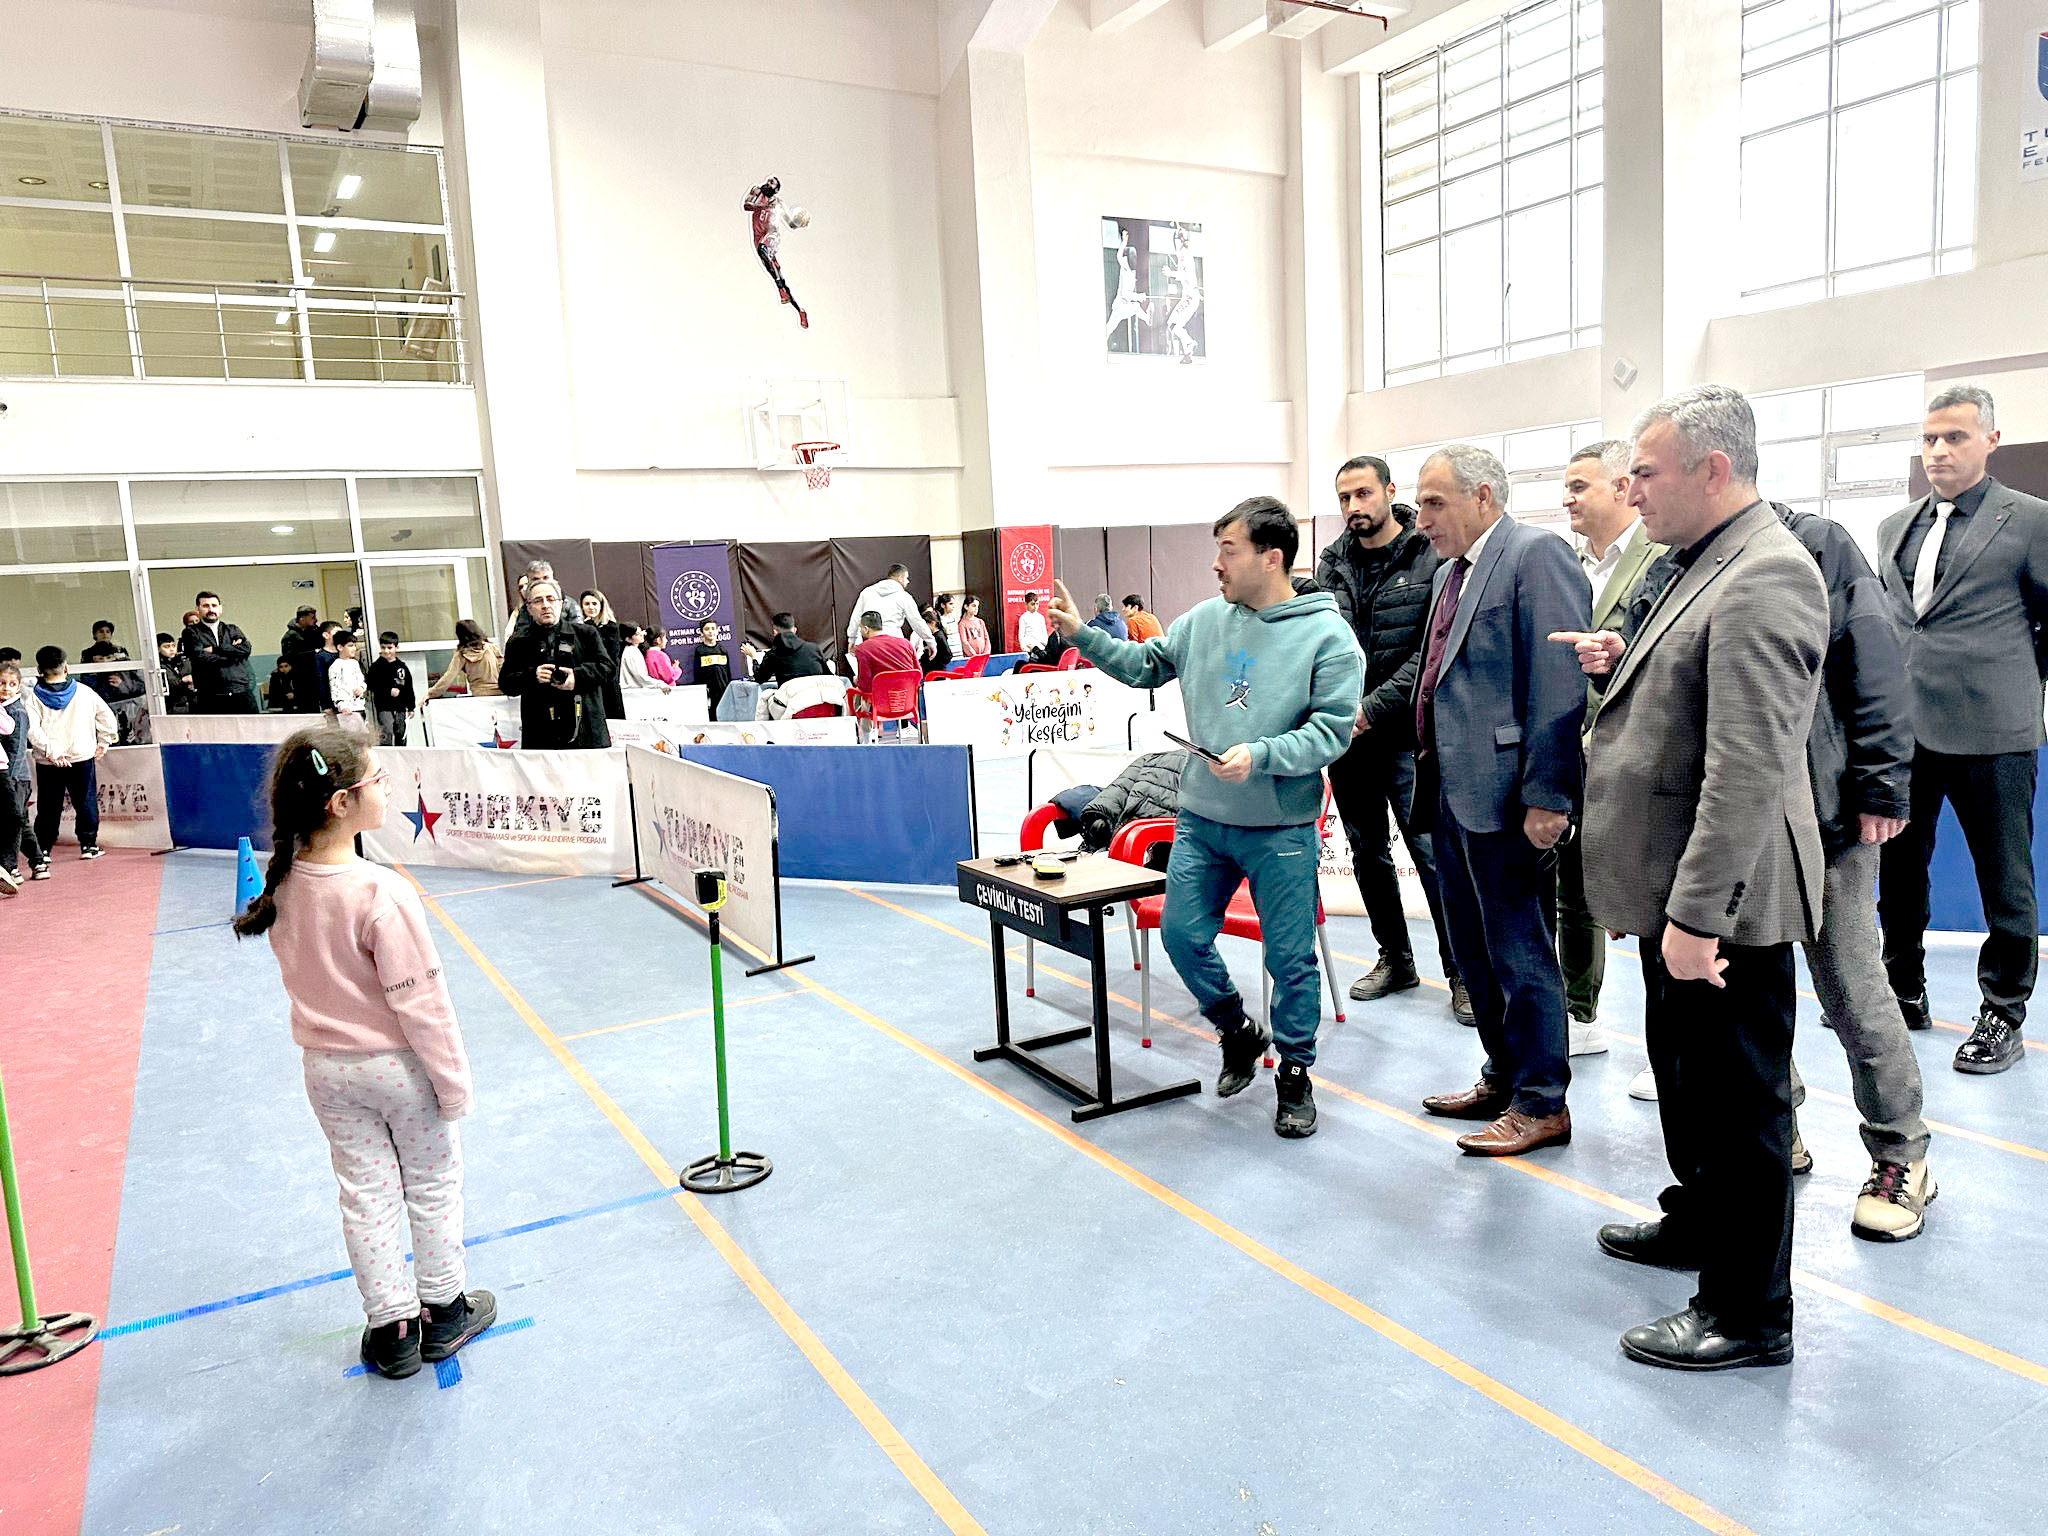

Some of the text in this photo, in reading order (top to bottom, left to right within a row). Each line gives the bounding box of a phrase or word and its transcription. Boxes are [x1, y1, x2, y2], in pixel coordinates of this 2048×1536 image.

[669, 628, 695, 637] BATMAN
[671, 637, 687, 645] SPOR
[1014, 701, 1082, 723] Yeteneğini
[442, 791, 602, 833] TÜRKİYE
[664, 806, 746, 885] TÜRKİYE
[976, 883, 1044, 926] ÇEVİKLİK TESTİ
